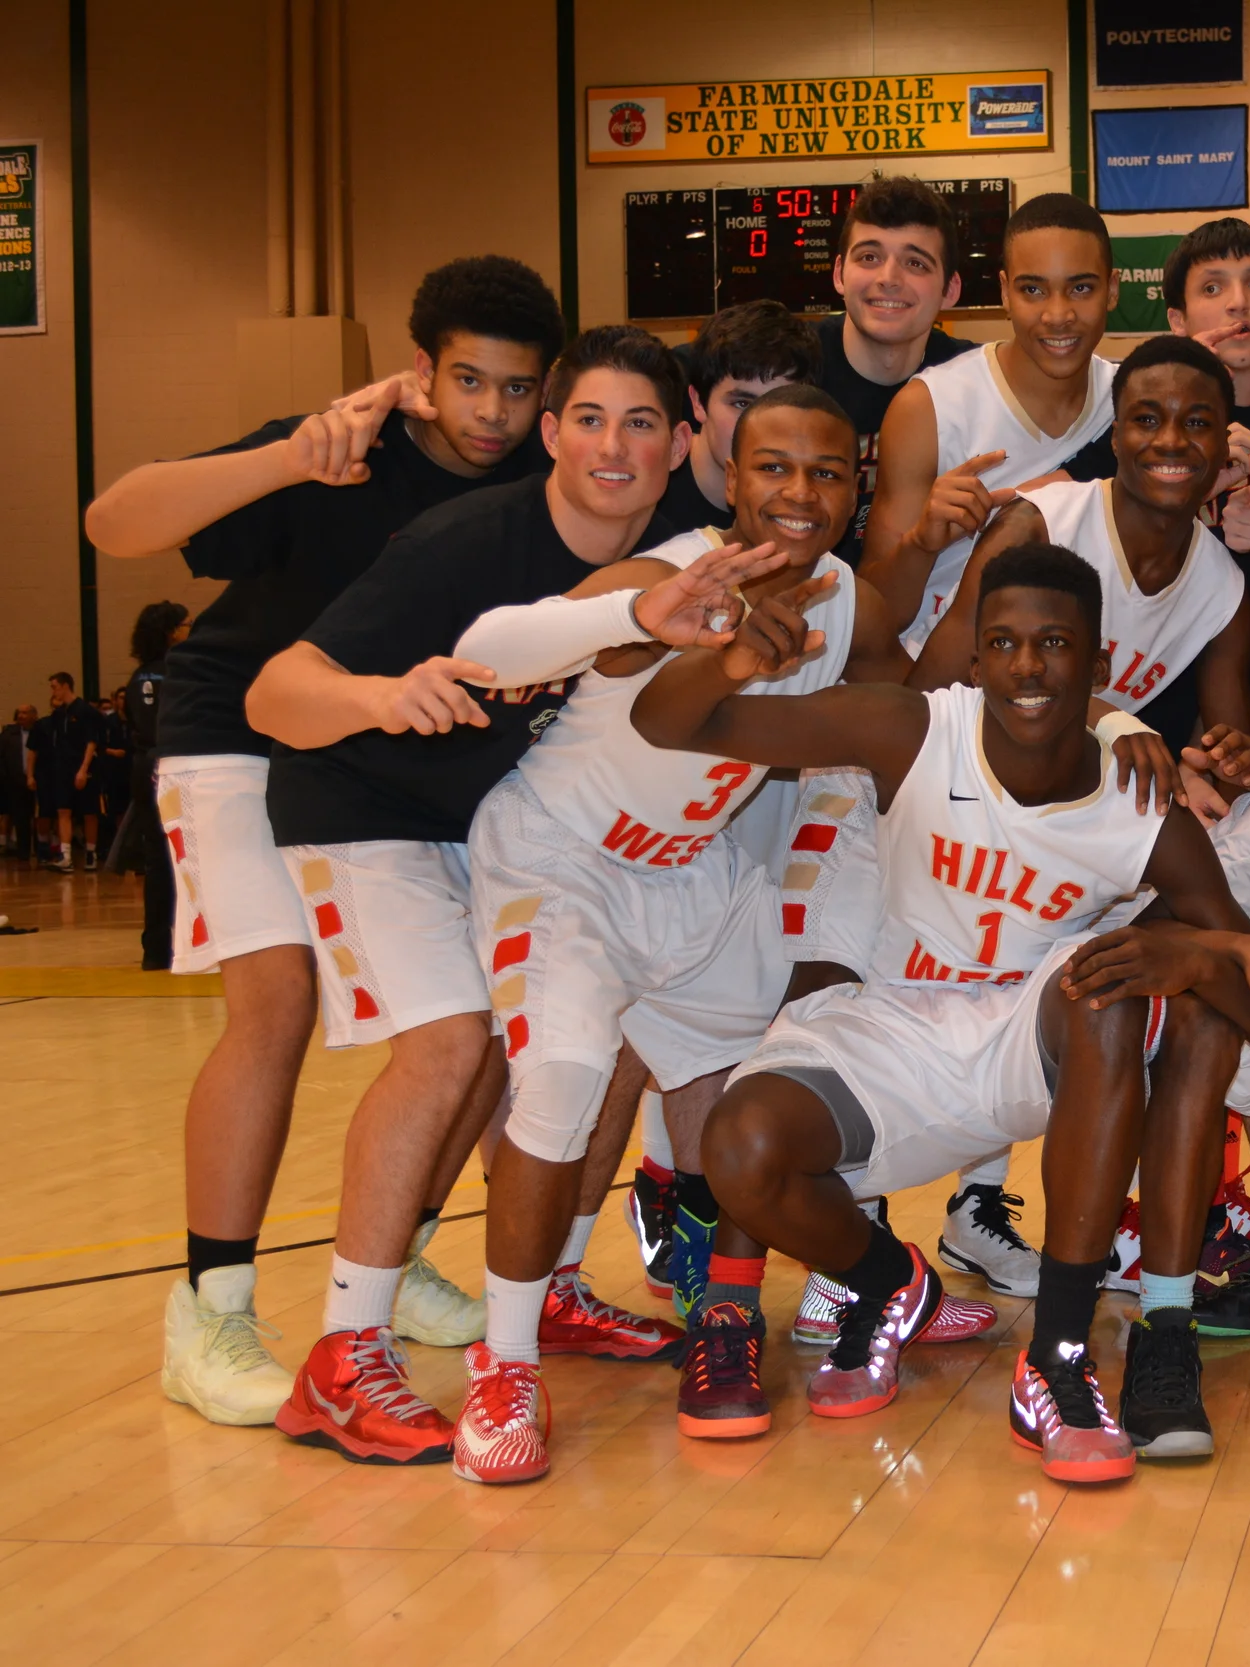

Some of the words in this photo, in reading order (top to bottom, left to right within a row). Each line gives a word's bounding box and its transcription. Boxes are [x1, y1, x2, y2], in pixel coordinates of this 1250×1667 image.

[1106, 26, 1232, 46] POLYTECHNIC
[698, 77, 934, 108] FARMINGDALE
[667, 109, 758, 133] STATE
[775, 101, 965, 130] UNIVERSITY
[707, 134, 744, 156] OF
[760, 131, 829, 155] NEW
[845, 128, 926, 152] YORK
[1107, 154, 1150, 168] MOUNT
[1156, 153, 1193, 166] SAINT
[1198, 151, 1235, 165] MARY
[961, 181, 969, 193] F
[980, 180, 1004, 192] PTS
[629, 194, 659, 205] PLYR
[665, 193, 673, 204] F
[683, 191, 707, 203] PTS
[752, 197, 763, 213] 6
[726, 216, 768, 230] HOME
[801, 219, 831, 228] PERIOD
[750, 229, 767, 257] 0
[804, 251, 829, 260] BONUS
[731, 266, 757, 275] FOULS
[803, 263, 831, 272] PLAYER
[804, 304, 831, 313] MATCH
[681, 761, 753, 822] 3
[930, 831, 1087, 923] HILLS
[975, 908, 1005, 968] 1
